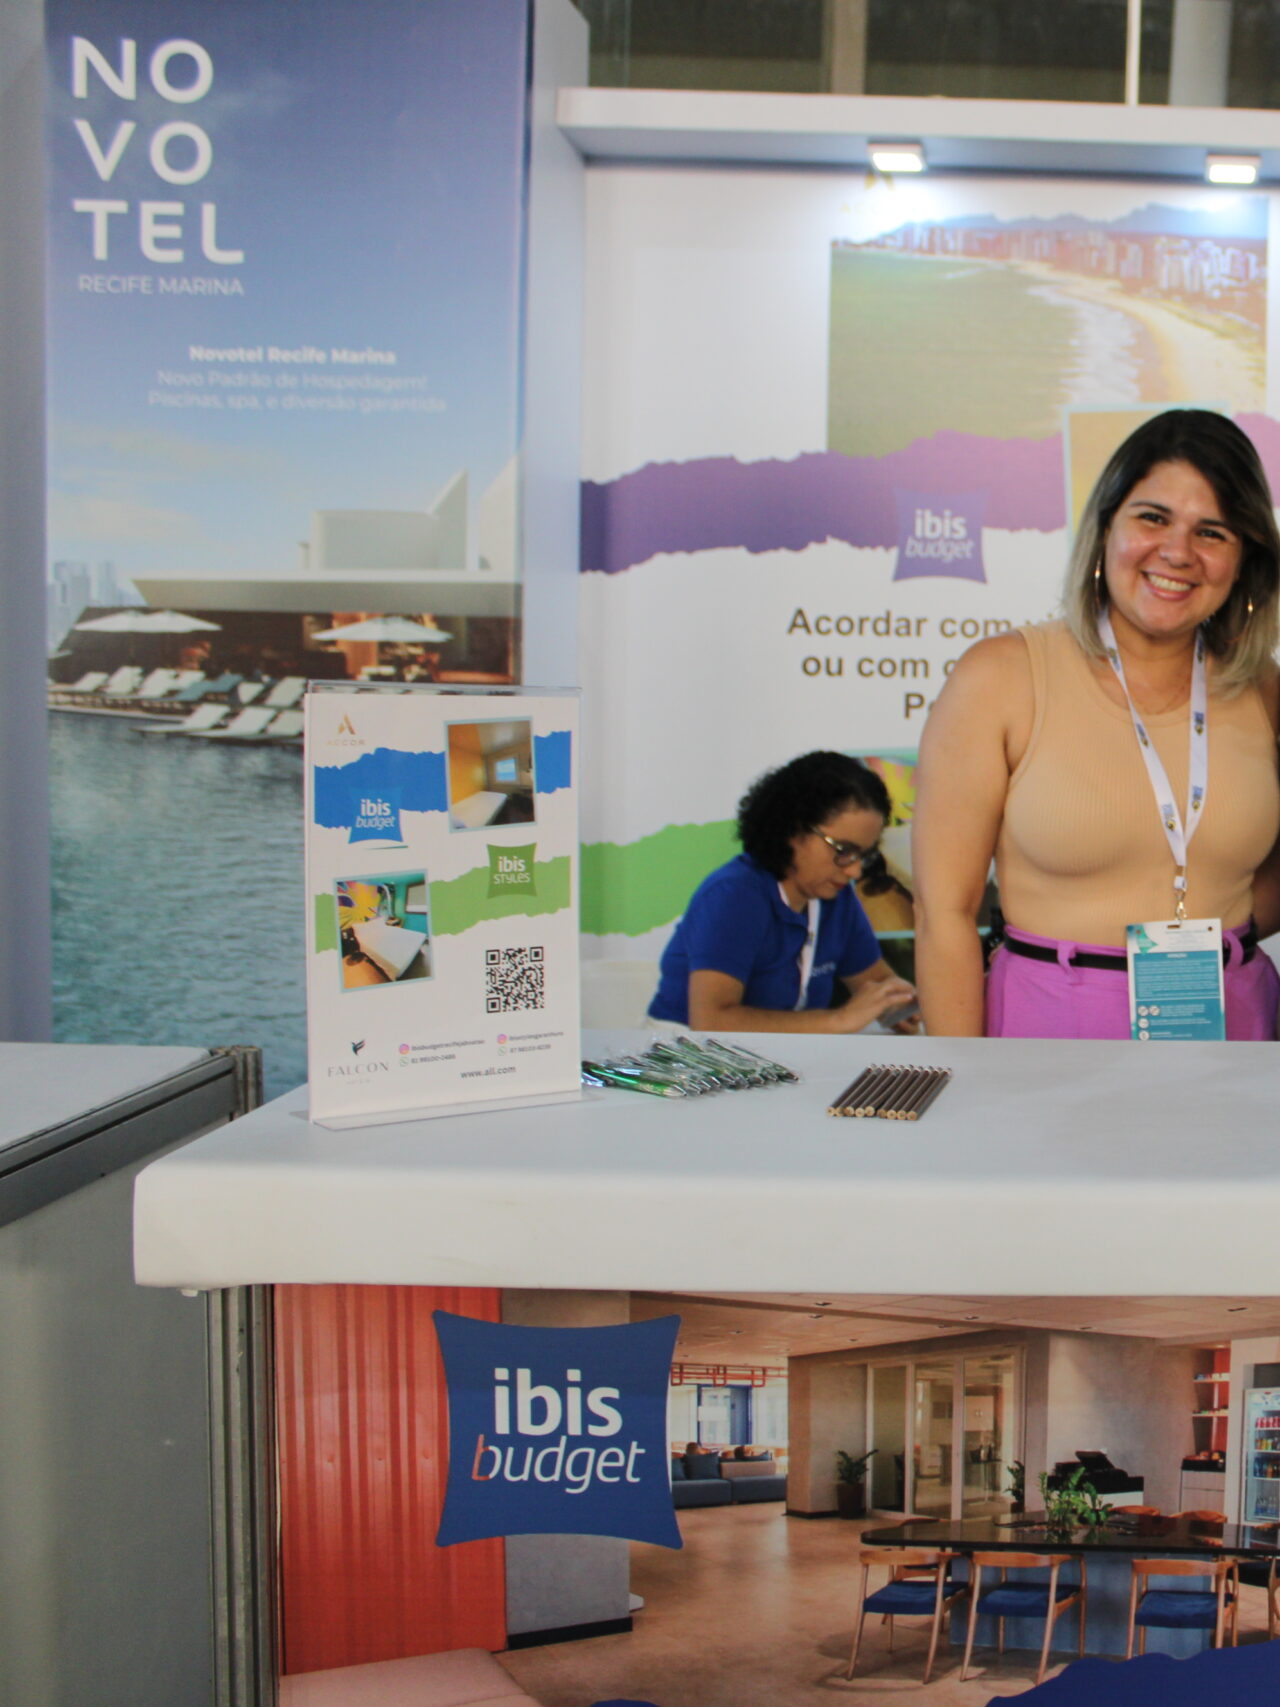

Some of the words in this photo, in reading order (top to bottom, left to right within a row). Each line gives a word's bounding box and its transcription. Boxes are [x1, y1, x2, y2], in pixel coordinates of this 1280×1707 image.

[73, 36, 213, 103] NO
[73, 119, 212, 185] VO
[73, 199, 244, 264] TEL
[79, 275, 152, 294] RECIFE
[159, 278, 244, 296] MARINA
[189, 345, 263, 363] Novotel
[267, 346, 326, 364] Recife
[331, 347, 397, 365] Marina
[914, 508, 968, 540] ibis
[904, 536, 975, 563] budget
[787, 607, 928, 638] Acordar
[940, 618, 1013, 639] com
[802, 655, 843, 677] ou
[857, 657, 930, 679] com
[360, 798, 391, 816] ibis
[355, 815, 396, 831] budget
[498, 856, 526, 873] ibis
[327, 1061, 389, 1077] FALCON
[460, 1065, 517, 1080] www.all.com
[494, 1367, 623, 1437] ibis
[471, 1434, 647, 1494] budget
